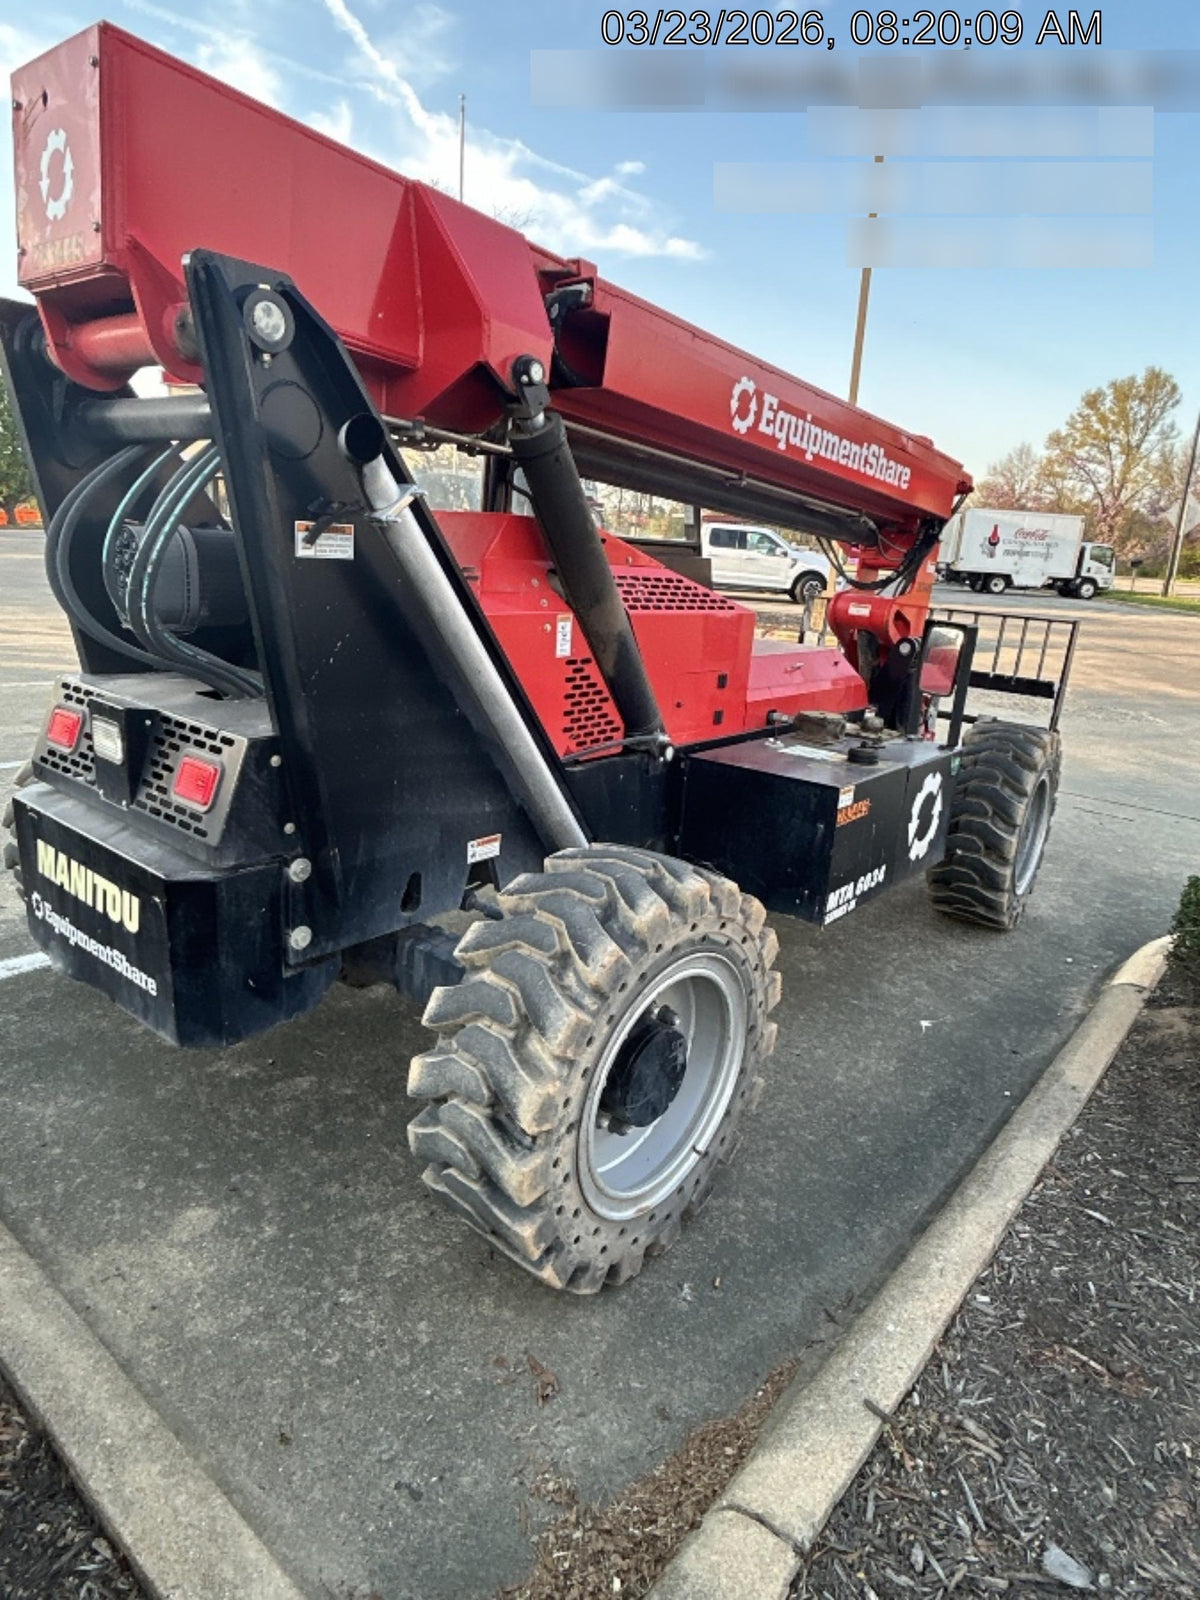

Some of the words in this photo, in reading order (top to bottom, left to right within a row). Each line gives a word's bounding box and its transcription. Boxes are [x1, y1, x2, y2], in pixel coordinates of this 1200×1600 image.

[758, 392, 912, 491] EquipmentShare
[36, 838, 141, 935] MANITOU
[826, 881, 855, 912] MTA
[43, 900, 158, 997] EquipmentShare
